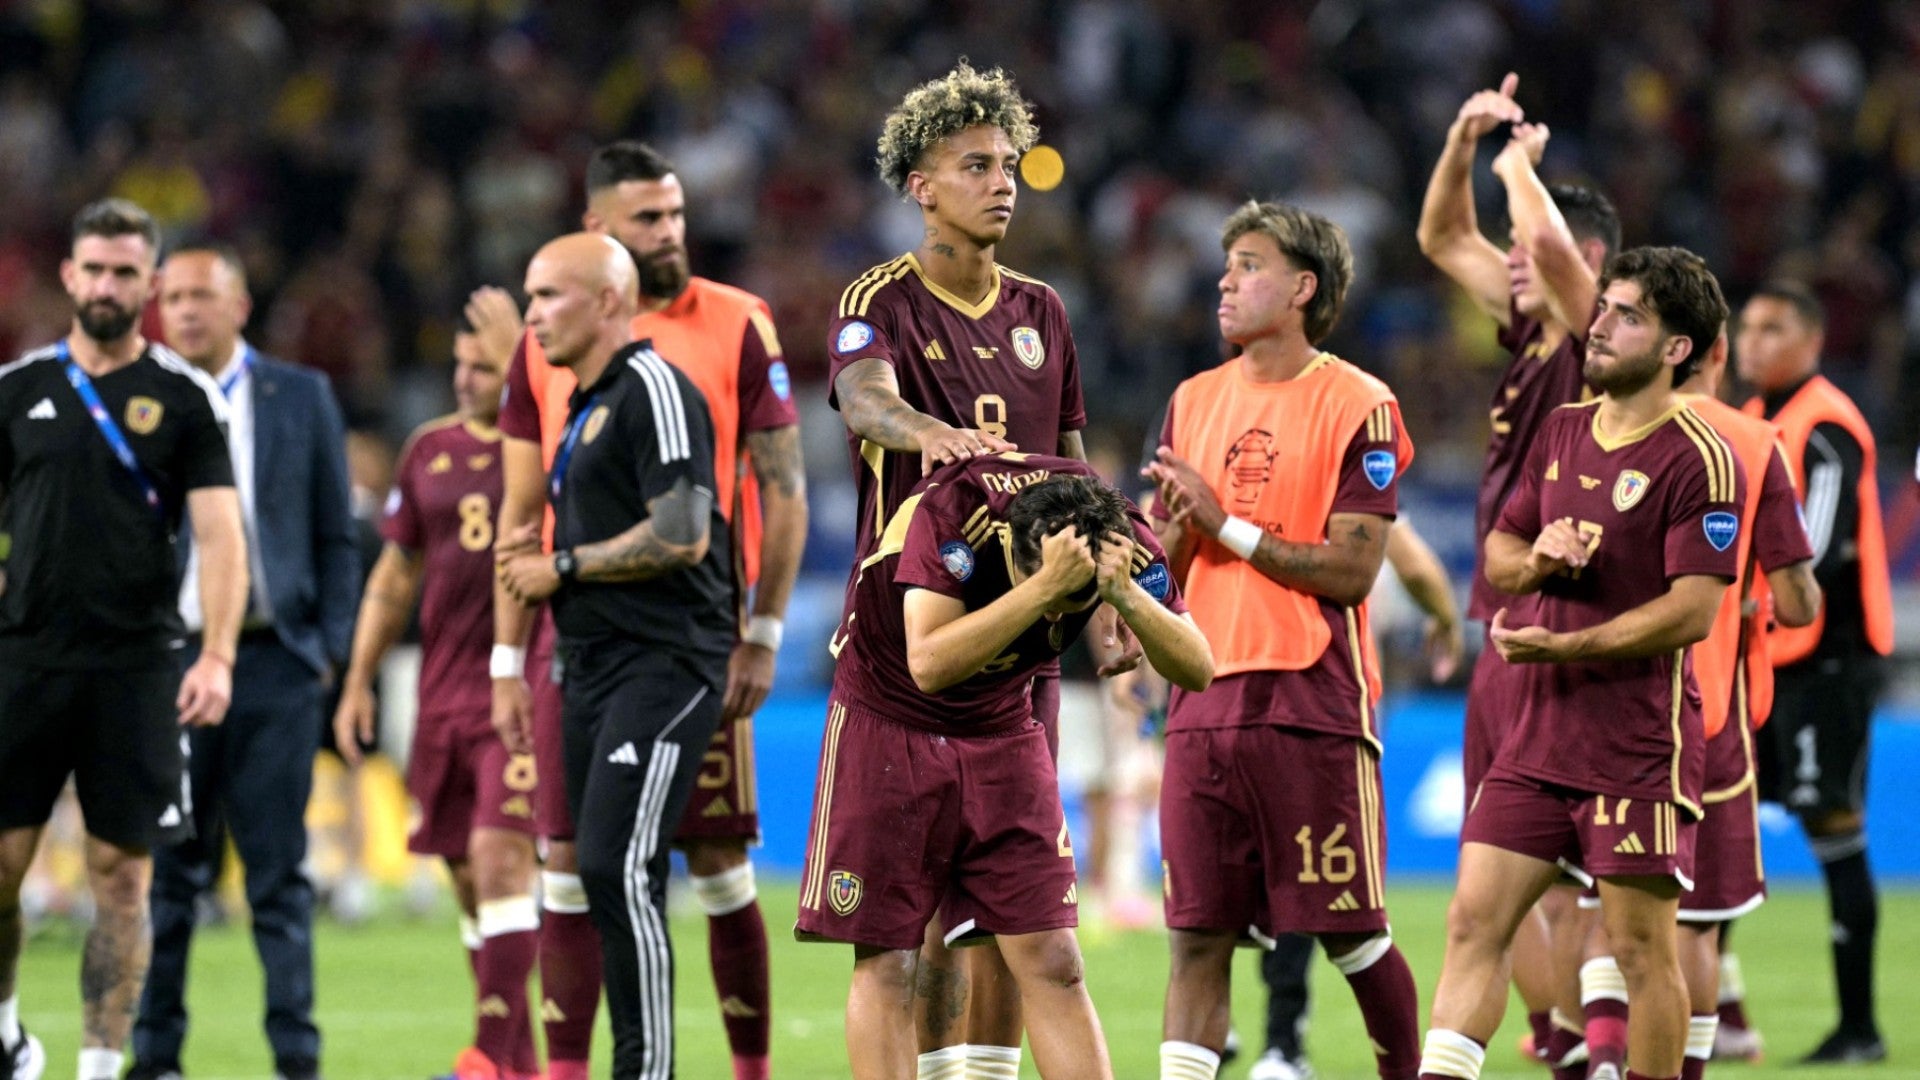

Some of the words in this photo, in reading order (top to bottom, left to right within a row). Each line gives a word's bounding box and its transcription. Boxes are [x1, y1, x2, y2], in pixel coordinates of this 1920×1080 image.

[459, 493, 492, 551] 8
[1138, 571, 1164, 585] VIBRA
[503, 753, 539, 793] 8
[1793, 724, 1822, 780] 1
[1594, 794, 1631, 826] 17
[1295, 823, 1356, 883] 16
